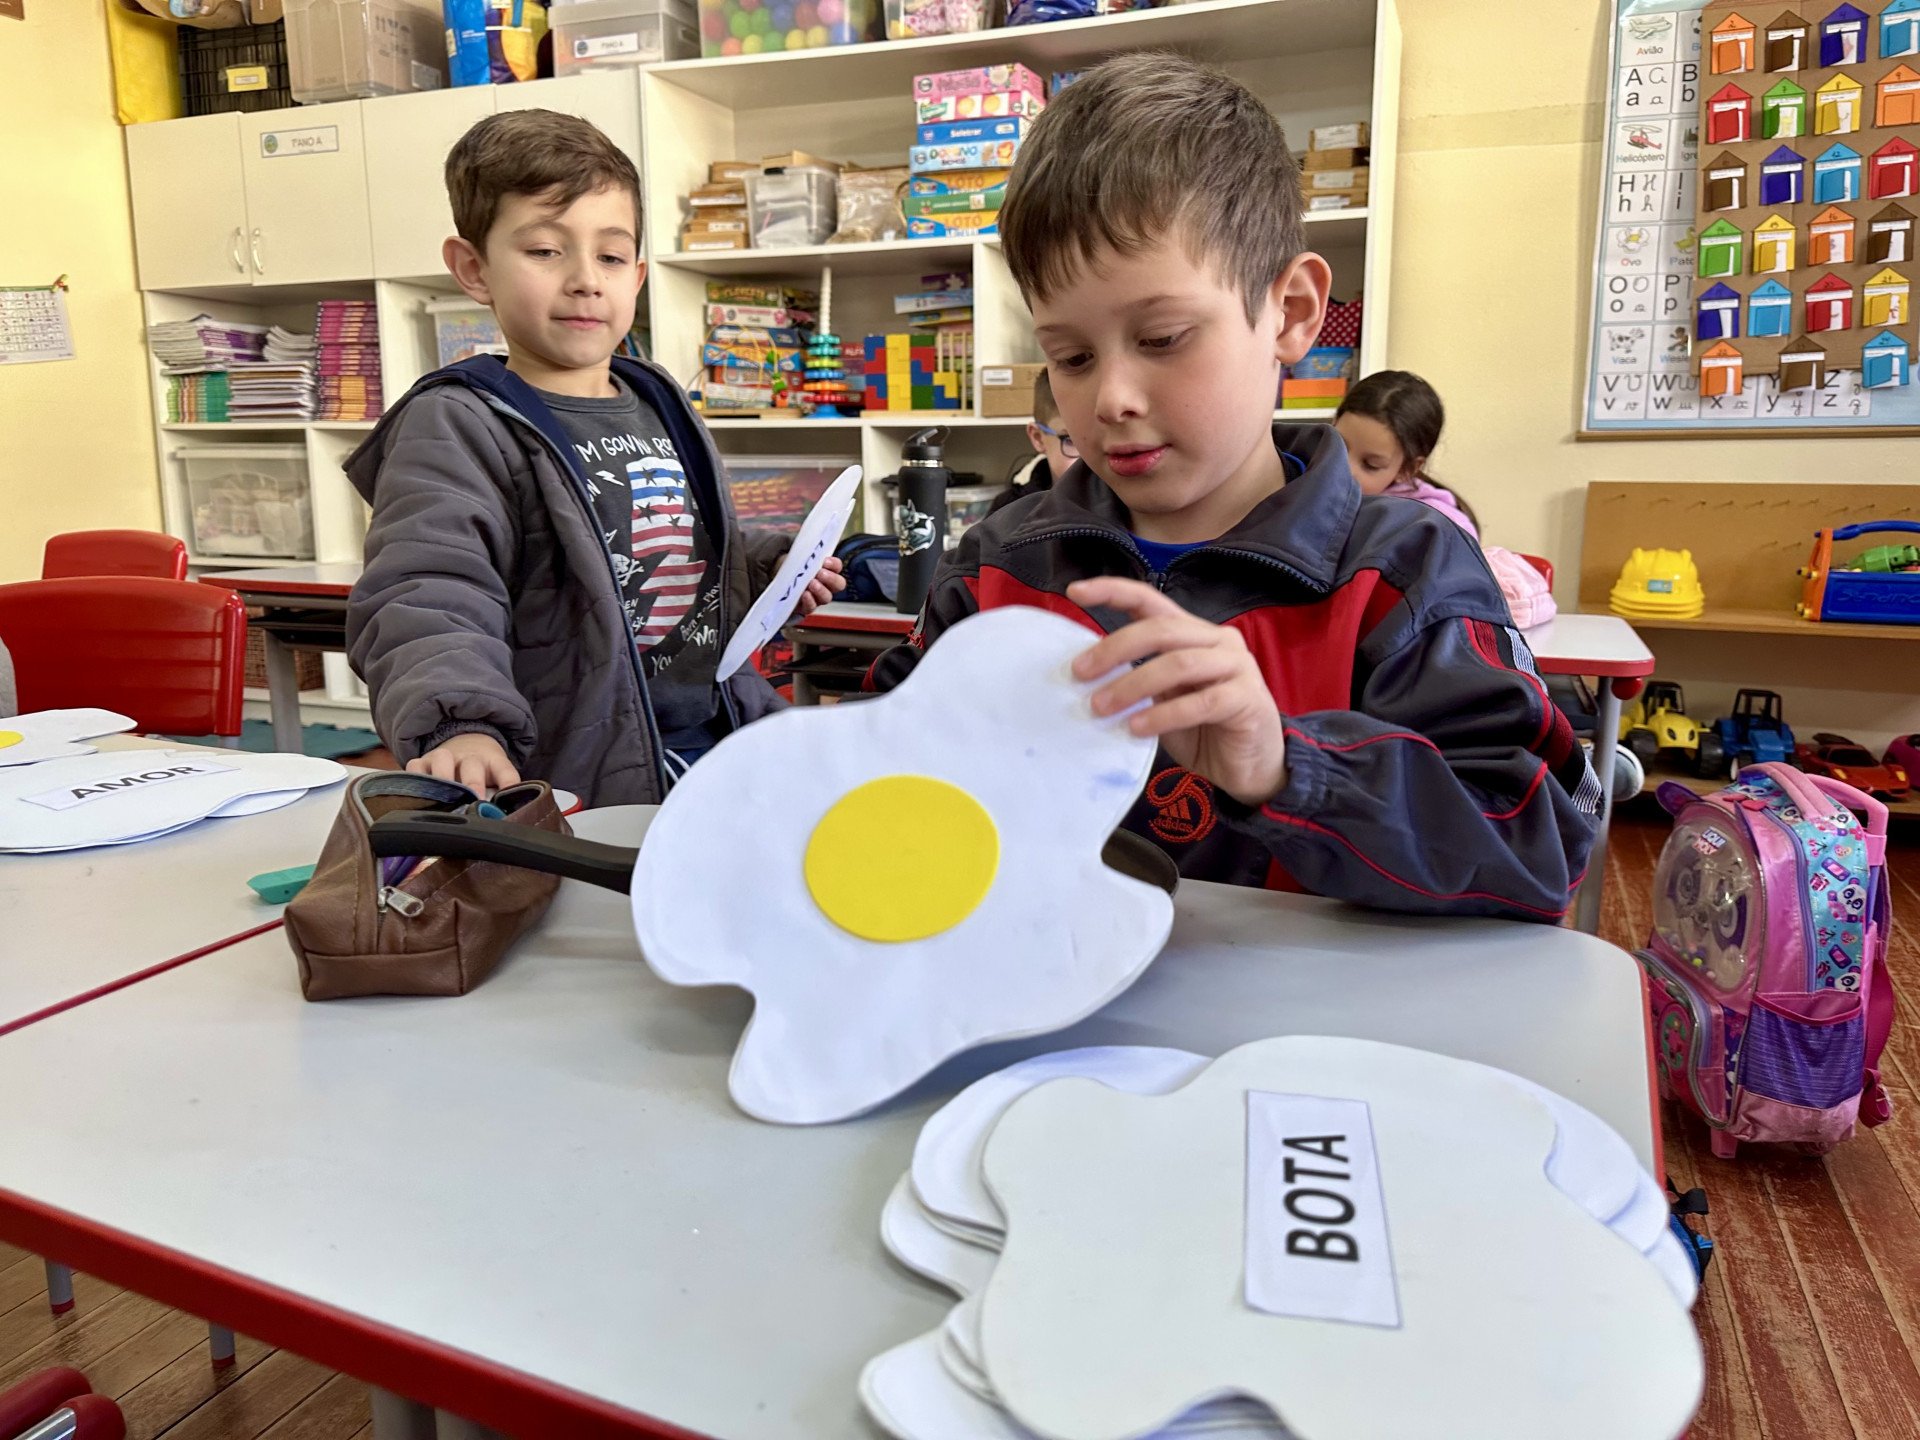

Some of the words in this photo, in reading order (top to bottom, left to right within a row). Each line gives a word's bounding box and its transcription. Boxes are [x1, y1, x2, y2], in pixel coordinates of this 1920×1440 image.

[1636, 45, 1663, 55] Avião
[1625, 68, 1643, 87] A
[1682, 63, 1698, 82] B
[1626, 92, 1639, 106] a
[1682, 84, 1695, 102] b
[1618, 174, 1635, 192] H
[1618, 194, 1631, 212] h
[1621, 258, 1642, 266] Ovo
[1609, 276, 1628, 294] O
[1664, 274, 1681, 292] P
[1664, 297, 1678, 315] p
[1611, 356, 1637, 364] Vaca
[1603, 375, 1620, 392] V
[1653, 374, 1677, 391] W
[1824, 370, 1841, 388] Z
[1767, 395, 1780, 412] y
[600, 433, 653, 457] GONNA
[71, 766, 206, 800] AMOR
[1153, 816, 1193, 833] adidas
[1281, 1134, 1360, 1263] BOTA
